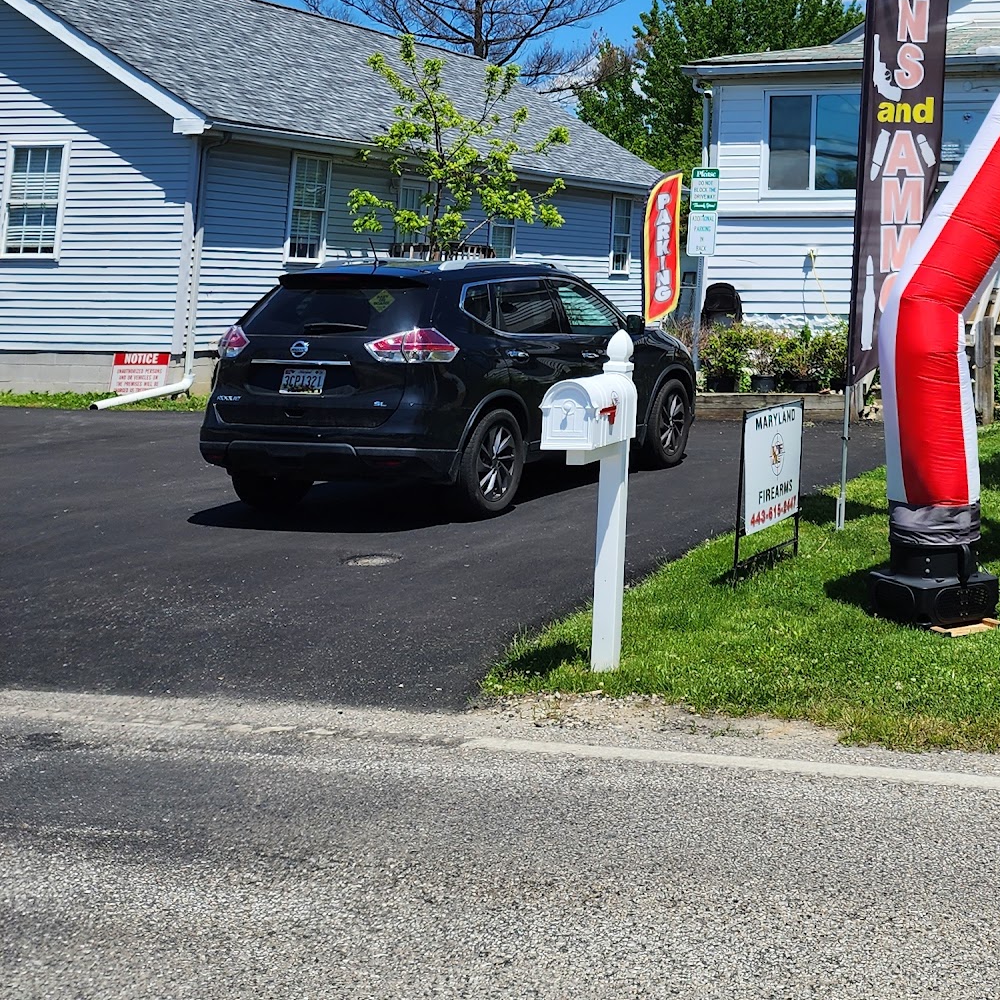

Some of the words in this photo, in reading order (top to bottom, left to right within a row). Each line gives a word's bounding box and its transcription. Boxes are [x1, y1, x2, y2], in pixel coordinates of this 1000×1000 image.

[877, 96, 935, 124] and
[696, 169, 717, 178] Please
[655, 192, 673, 303] PARKING
[124, 353, 160, 364] NOTICE
[283, 375, 323, 388] 3CP1321
[755, 408, 796, 431] MARYLAND
[758, 479, 793, 505] FIREARMS
